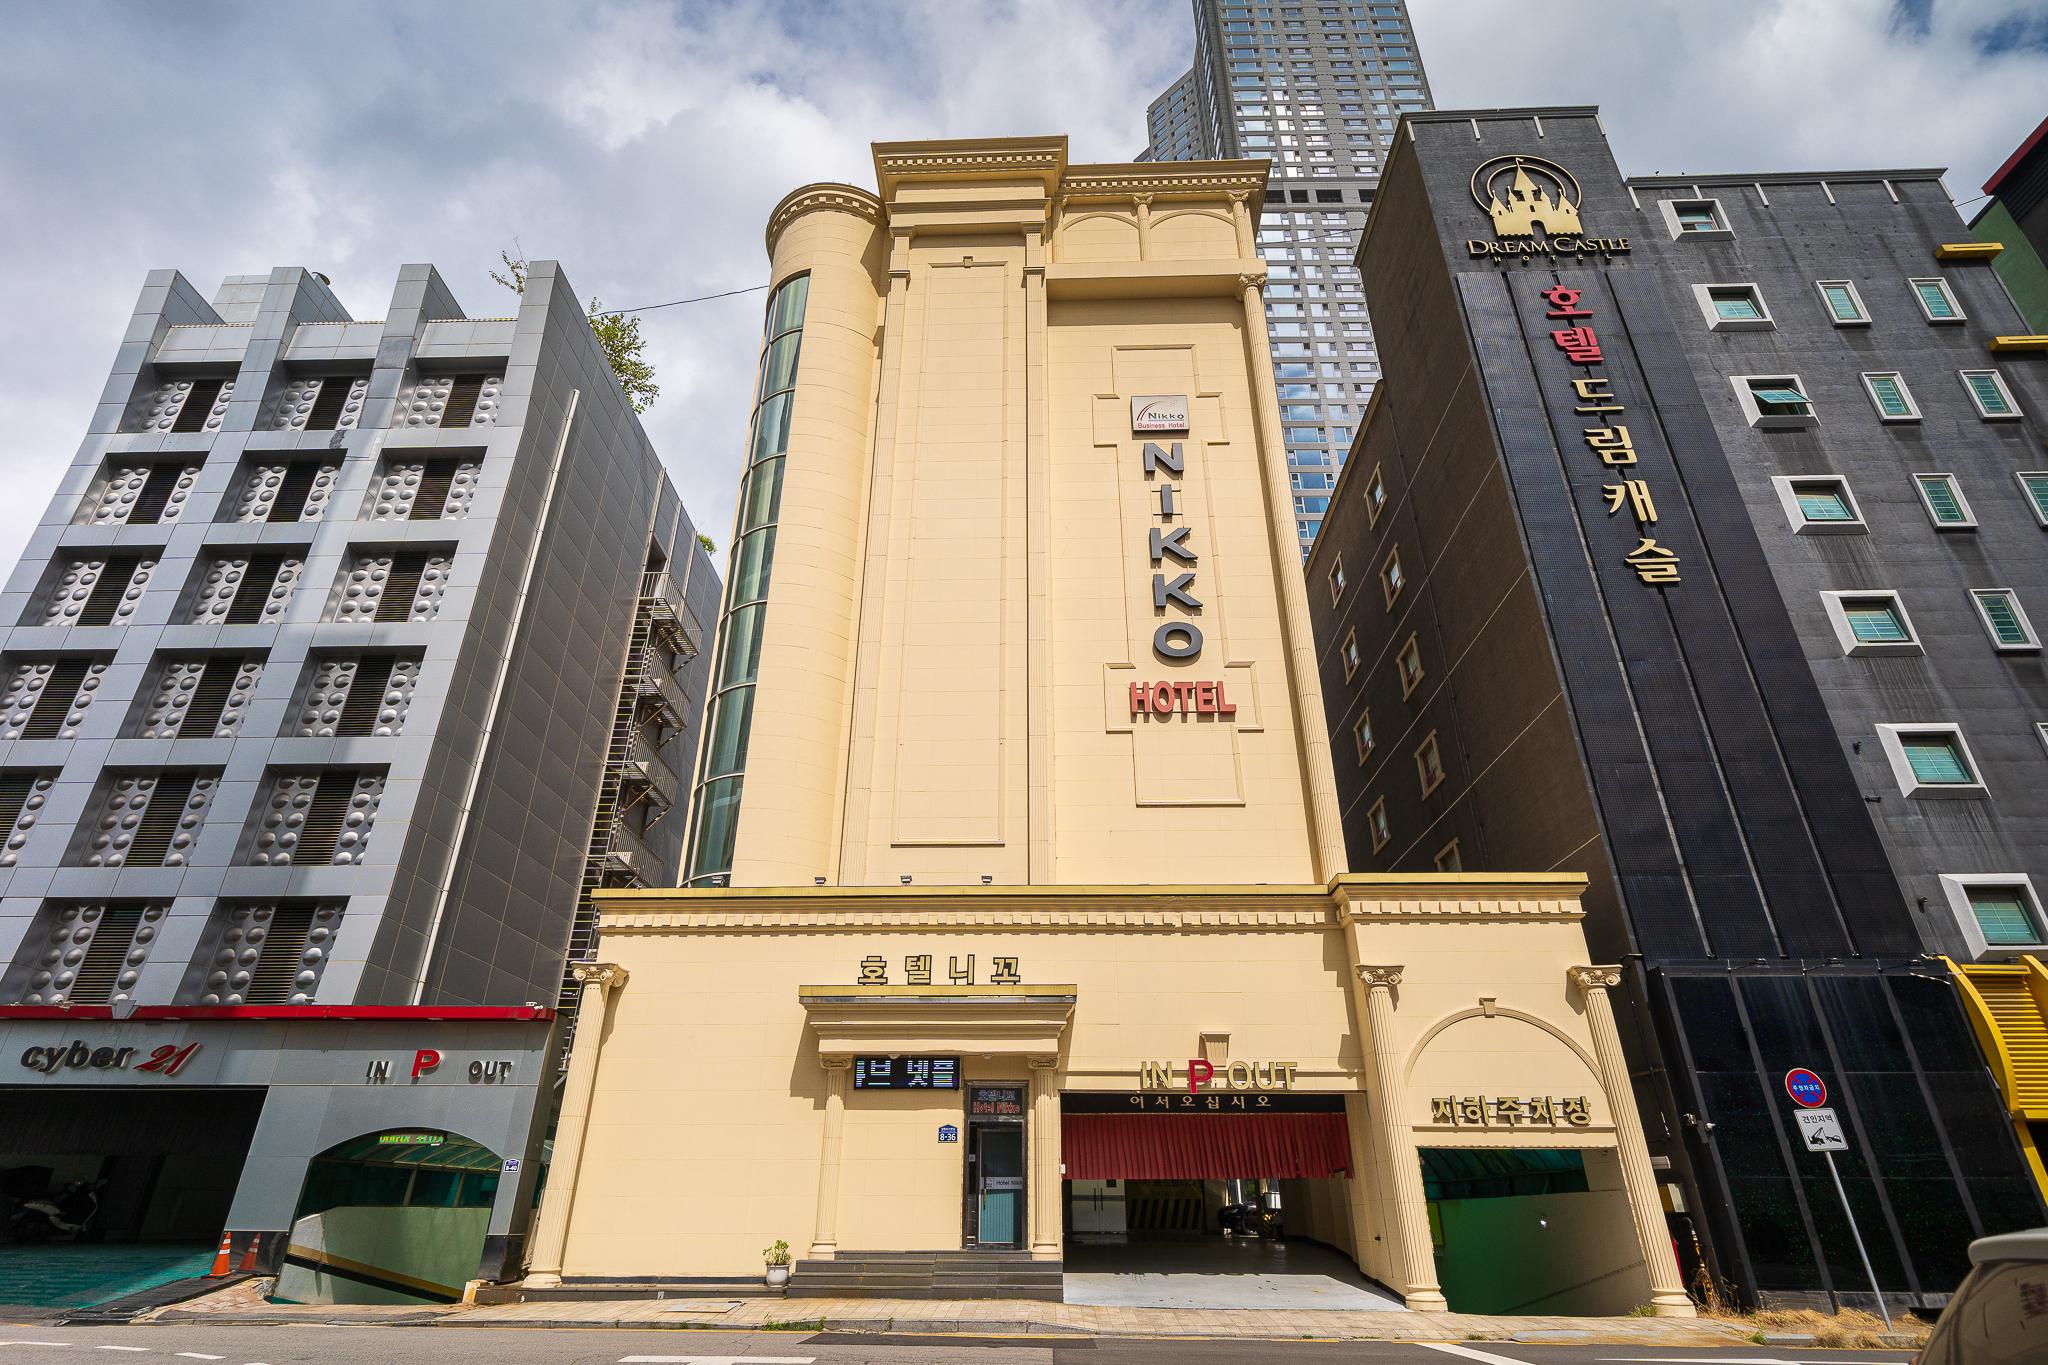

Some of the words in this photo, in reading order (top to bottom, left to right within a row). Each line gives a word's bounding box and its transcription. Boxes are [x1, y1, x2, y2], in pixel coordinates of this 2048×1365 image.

[1494, 254, 1613, 263] HOTEL
[1148, 412, 1185, 420] Nikko
[1143, 442, 1203, 657] NIKKO
[1130, 681, 1236, 714] HOTEL
[20, 1040, 136, 1073] cyber
[133, 1042, 202, 1076] 21
[365, 1060, 391, 1078] IN
[411, 1049, 445, 1079] P
[468, 1060, 513, 1078] OUT
[1140, 1060, 1174, 1090] IN
[1188, 1059, 1214, 1095] P
[1227, 1060, 1298, 1091] OUT
[973, 1102, 994, 1113] Hotel
[1431, 1095, 1592, 1127] 지하주차장
[1802, 1114, 1833, 1123] 견인지역
[939, 1133, 956, 1141] 8-36
